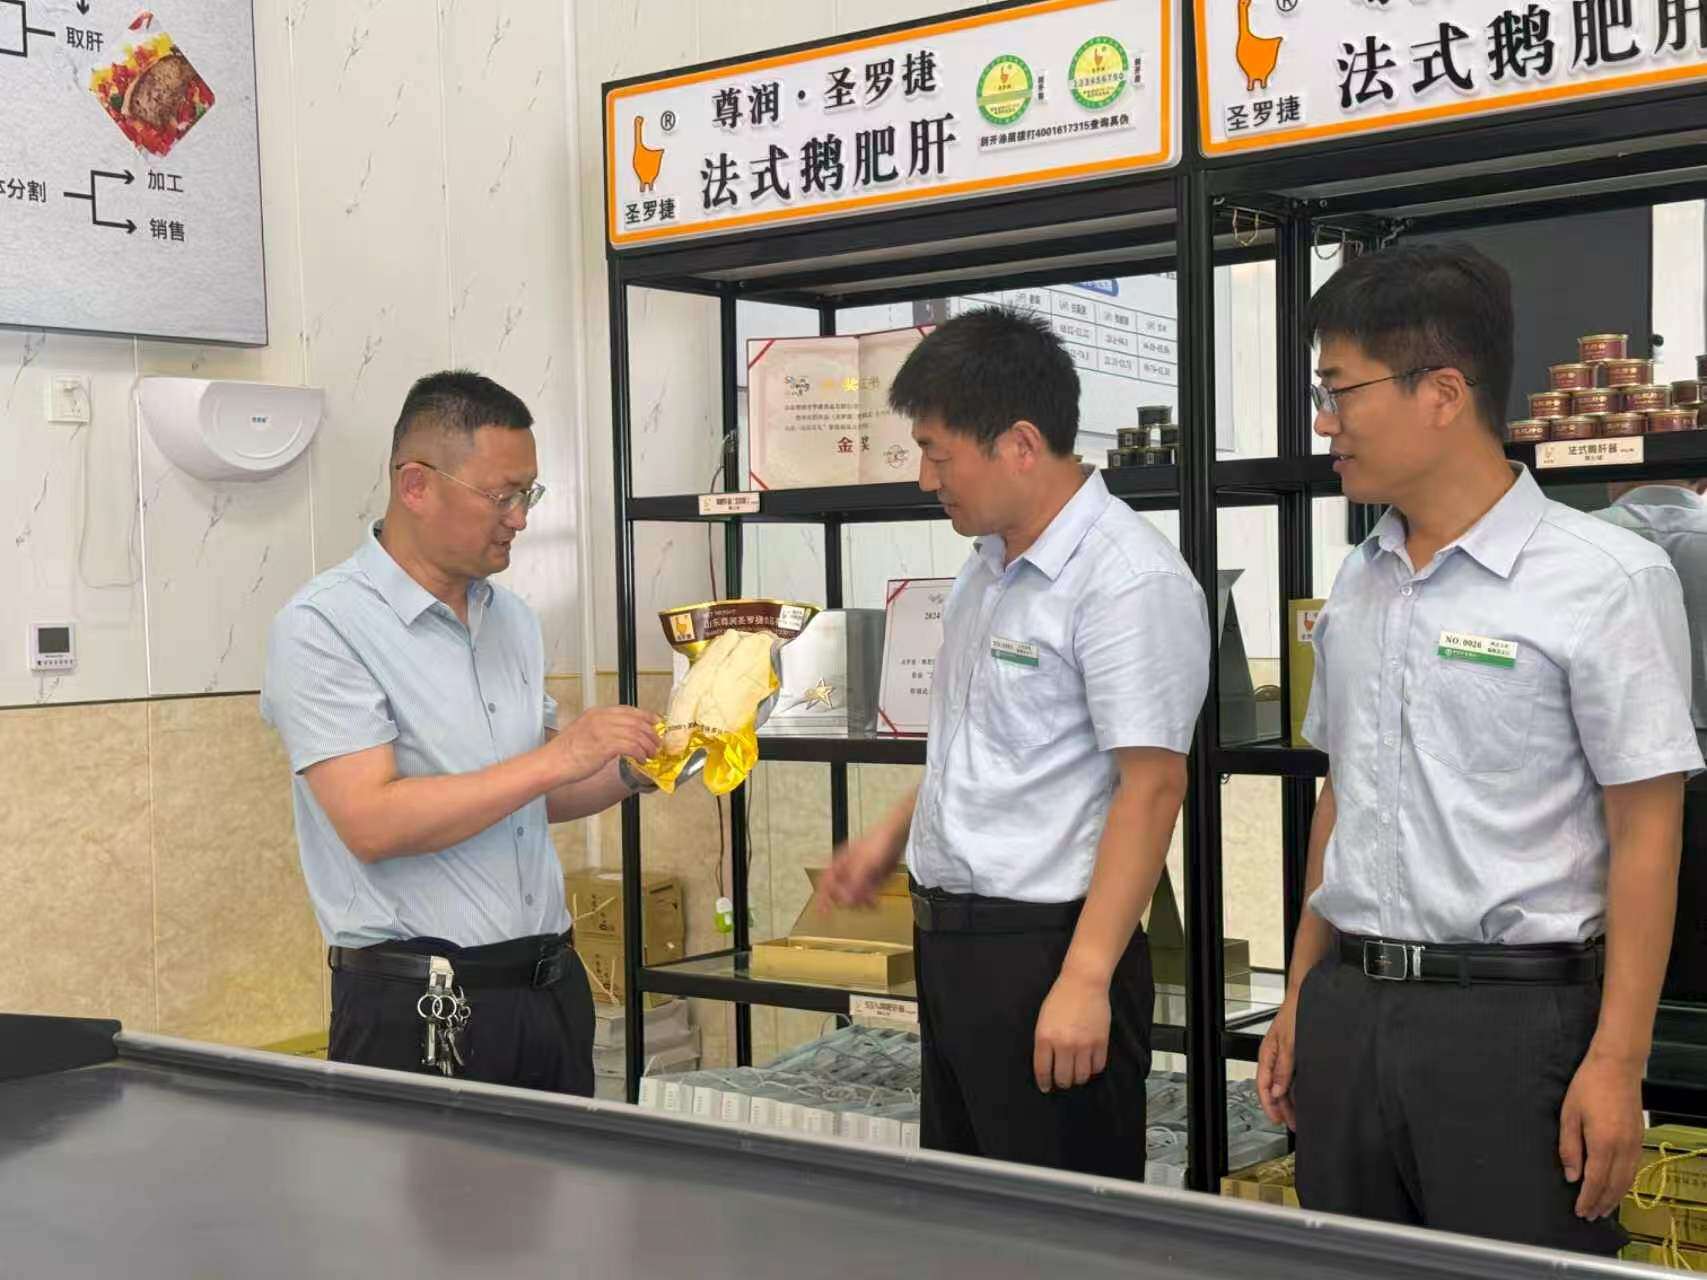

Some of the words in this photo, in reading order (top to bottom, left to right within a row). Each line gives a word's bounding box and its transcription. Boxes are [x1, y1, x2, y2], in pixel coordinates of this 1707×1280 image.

[66, 26, 104, 53] 取肝
[1226, 95, 1302, 132] 圣罗捷
[700, 112, 957, 209] 法式鹅肥肝
[147, 169, 185, 193] 加工
[625, 197, 676, 225] 圣罗捷
[149, 218, 186, 242] 销售
